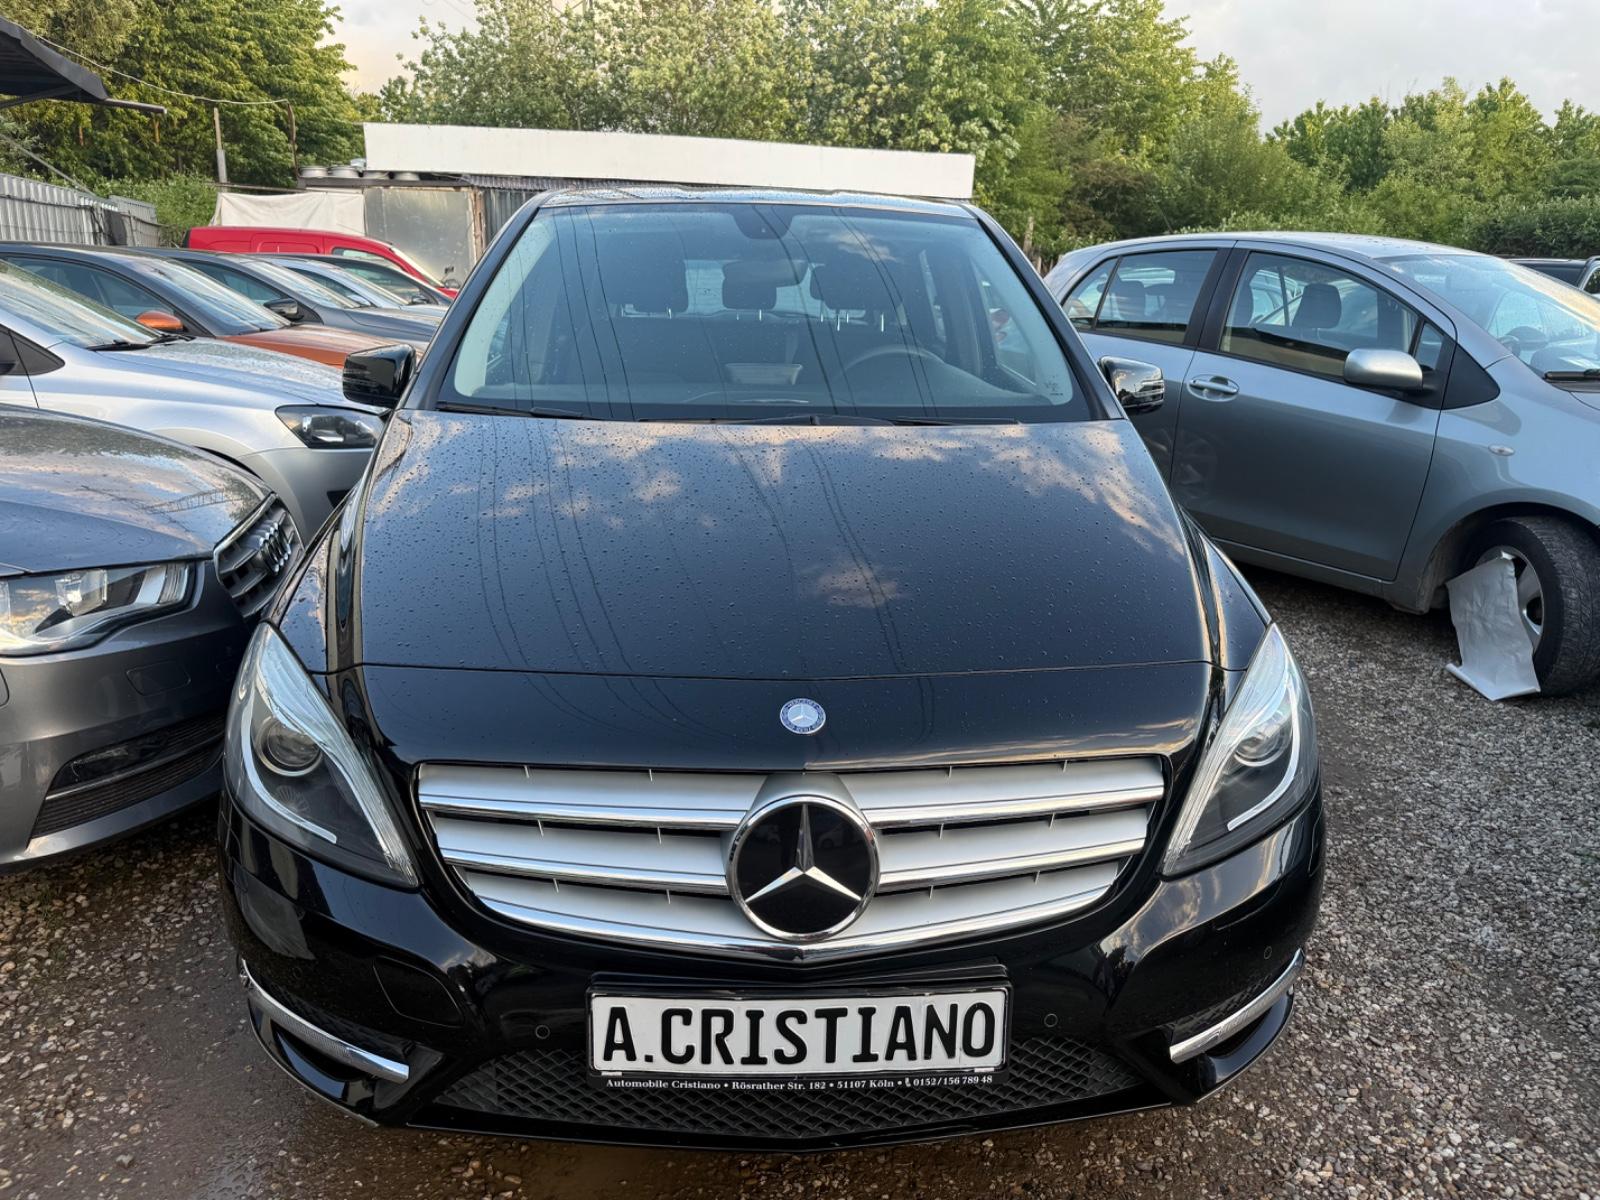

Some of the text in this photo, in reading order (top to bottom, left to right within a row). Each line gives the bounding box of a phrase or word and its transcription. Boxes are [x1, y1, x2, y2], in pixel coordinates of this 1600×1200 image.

[603, 1002, 996, 1065] A.CRISTIANO
[606, 1075, 993, 1091] Automobile Cristiano Rösrather Str. 182 51107 Köln 0152/156 789 48
